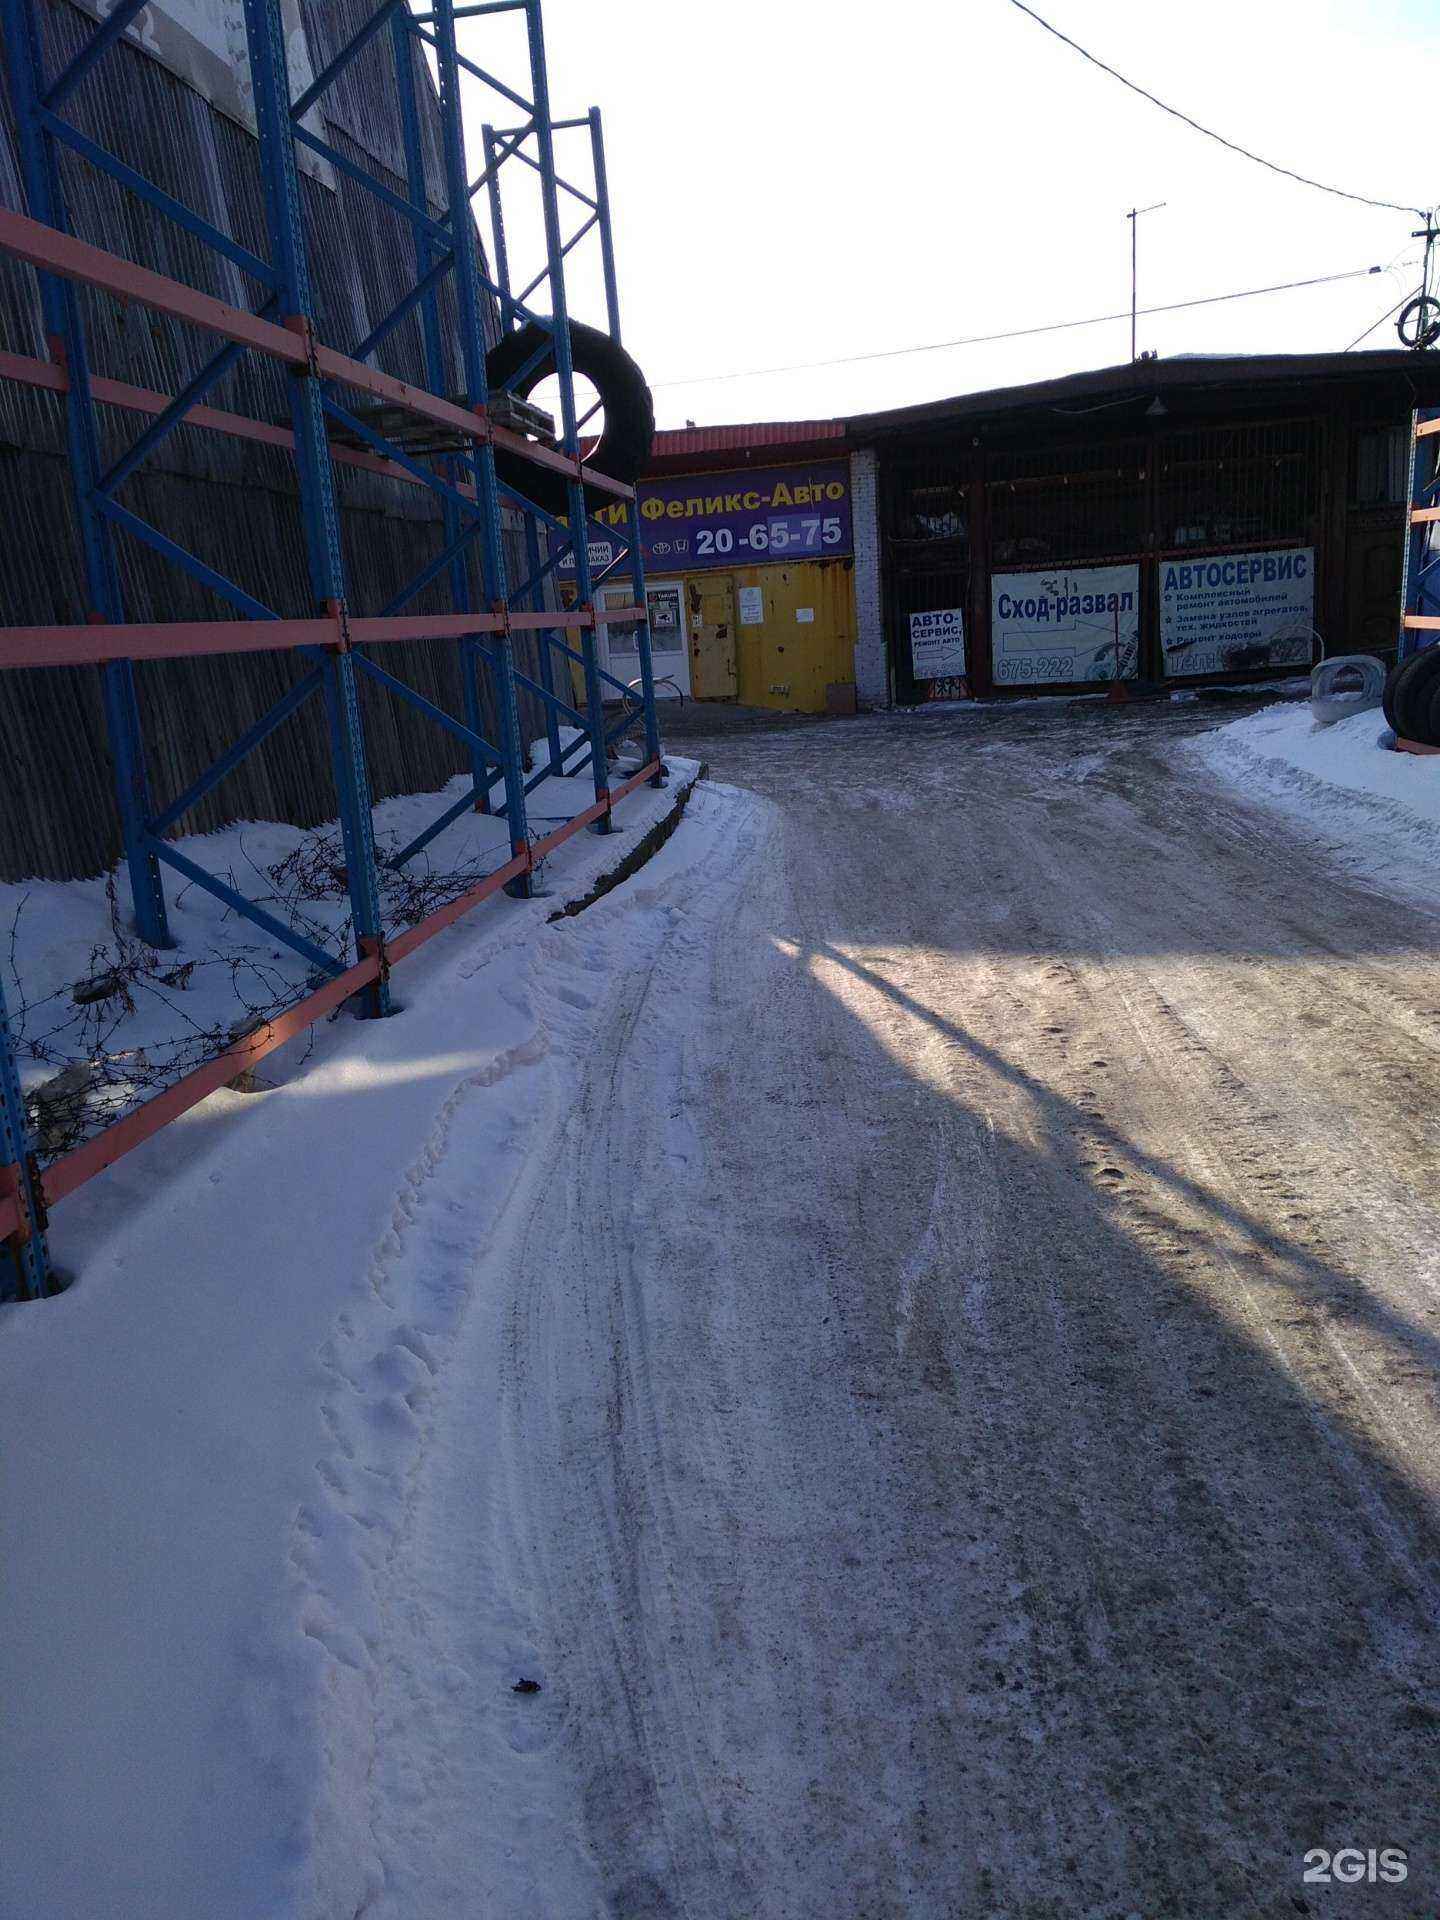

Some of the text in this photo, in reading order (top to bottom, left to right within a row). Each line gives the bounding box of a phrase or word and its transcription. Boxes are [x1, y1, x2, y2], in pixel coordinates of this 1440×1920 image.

[640, 482, 845, 520] Феликс-Авто
[1164, 555, 1307, 591] АВТОСЕРВИС
[1176, 590, 1251, 601] Комплексный
[1176, 593, 1287, 611] ремонт автомобилей
[998, 592, 1134, 622] Сход-развал
[912, 613, 959, 628] АВТО-
[1176, 613, 1216, 624] Замена
[1200, 618, 1258, 631] жидкостей
[998, 656, 1074, 680] 675-222
